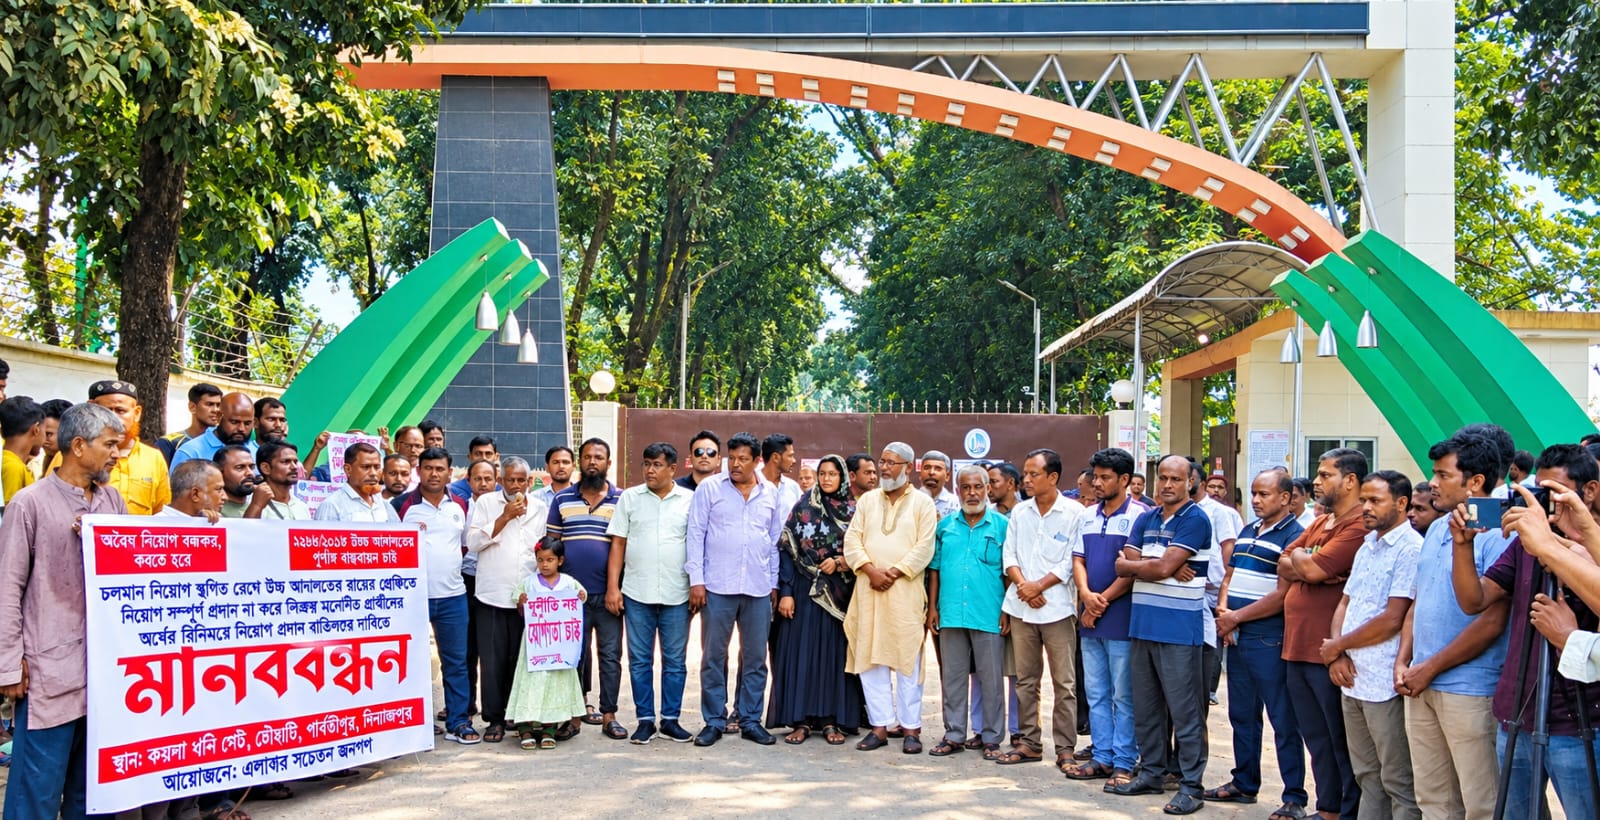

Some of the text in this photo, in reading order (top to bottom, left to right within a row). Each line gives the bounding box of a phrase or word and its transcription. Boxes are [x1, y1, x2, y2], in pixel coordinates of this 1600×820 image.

[99, 583, 146, 601] চলমান
[241, 601, 255, 617] না
[258, 601, 282, 616] করে
[116, 634, 413, 717] মানববন্ধন
[291, 744, 335, 769] সচেতন
